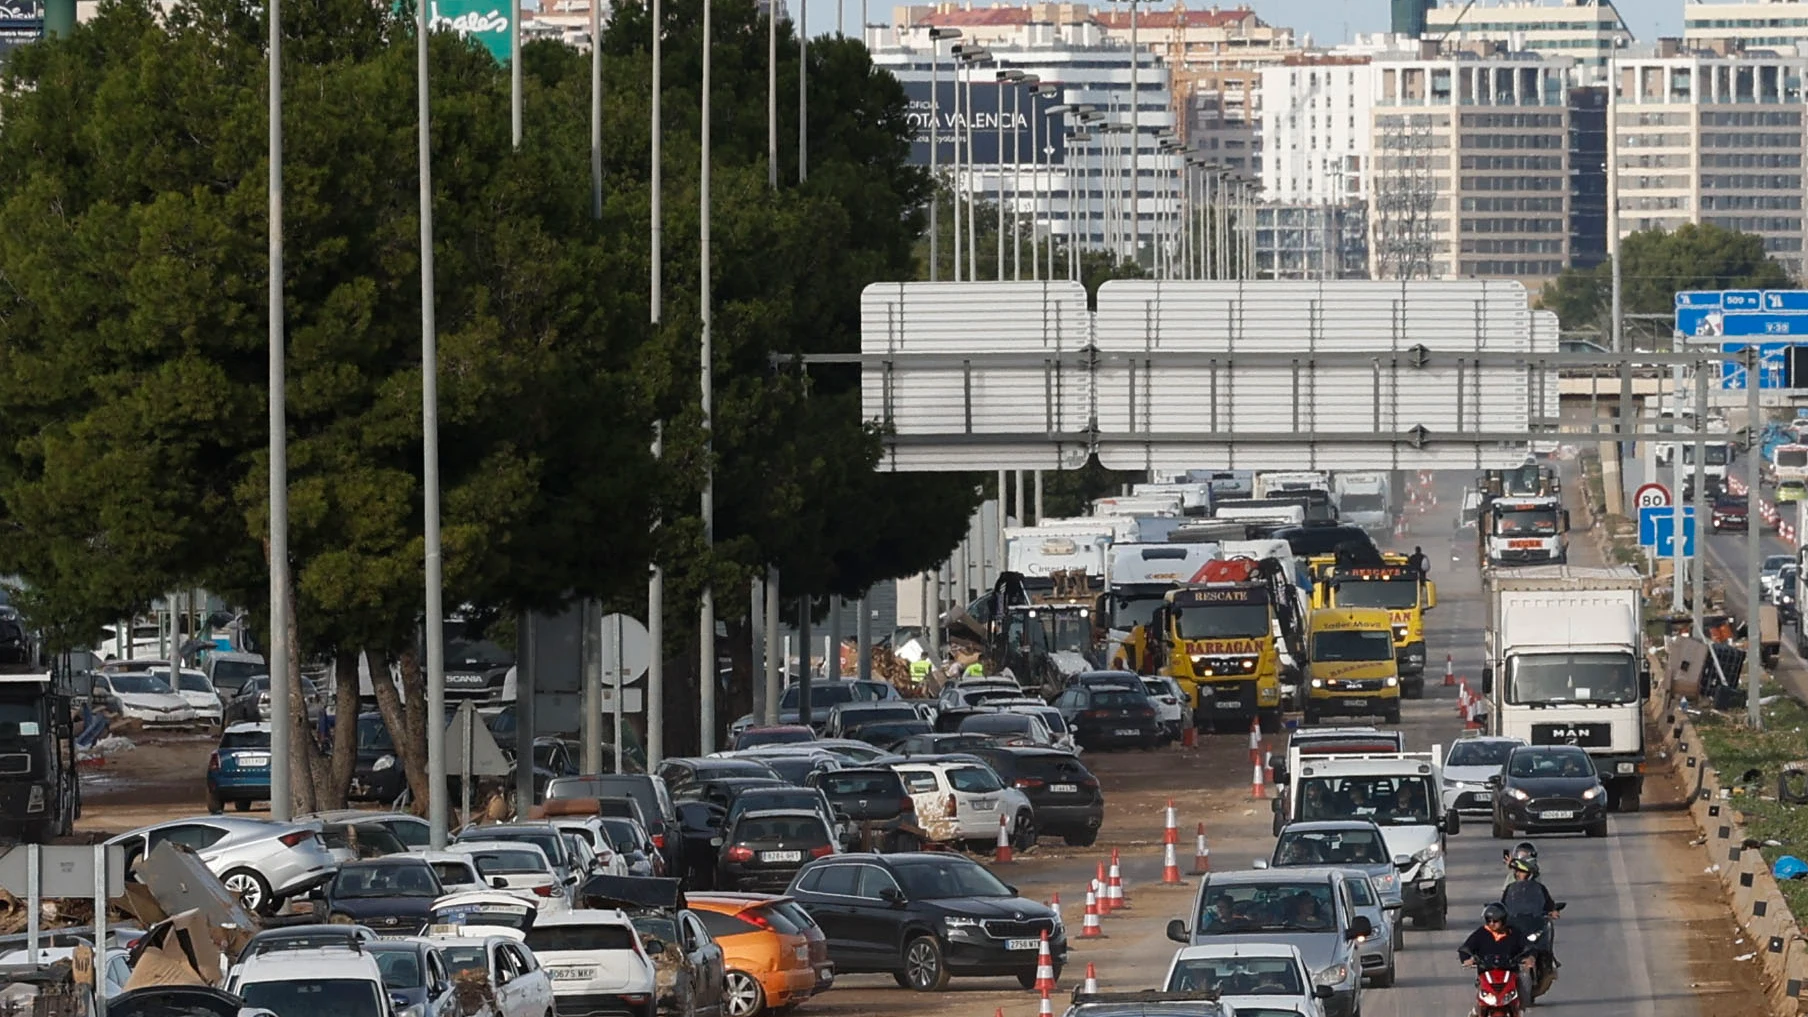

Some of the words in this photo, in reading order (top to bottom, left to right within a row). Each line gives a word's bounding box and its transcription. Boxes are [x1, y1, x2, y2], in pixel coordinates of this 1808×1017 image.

[1642, 495, 1663, 506] 80
[1194, 591, 1248, 601] RESCATE
[446, 675, 483, 683] SCANIA
[1553, 729, 1590, 738] MAN
